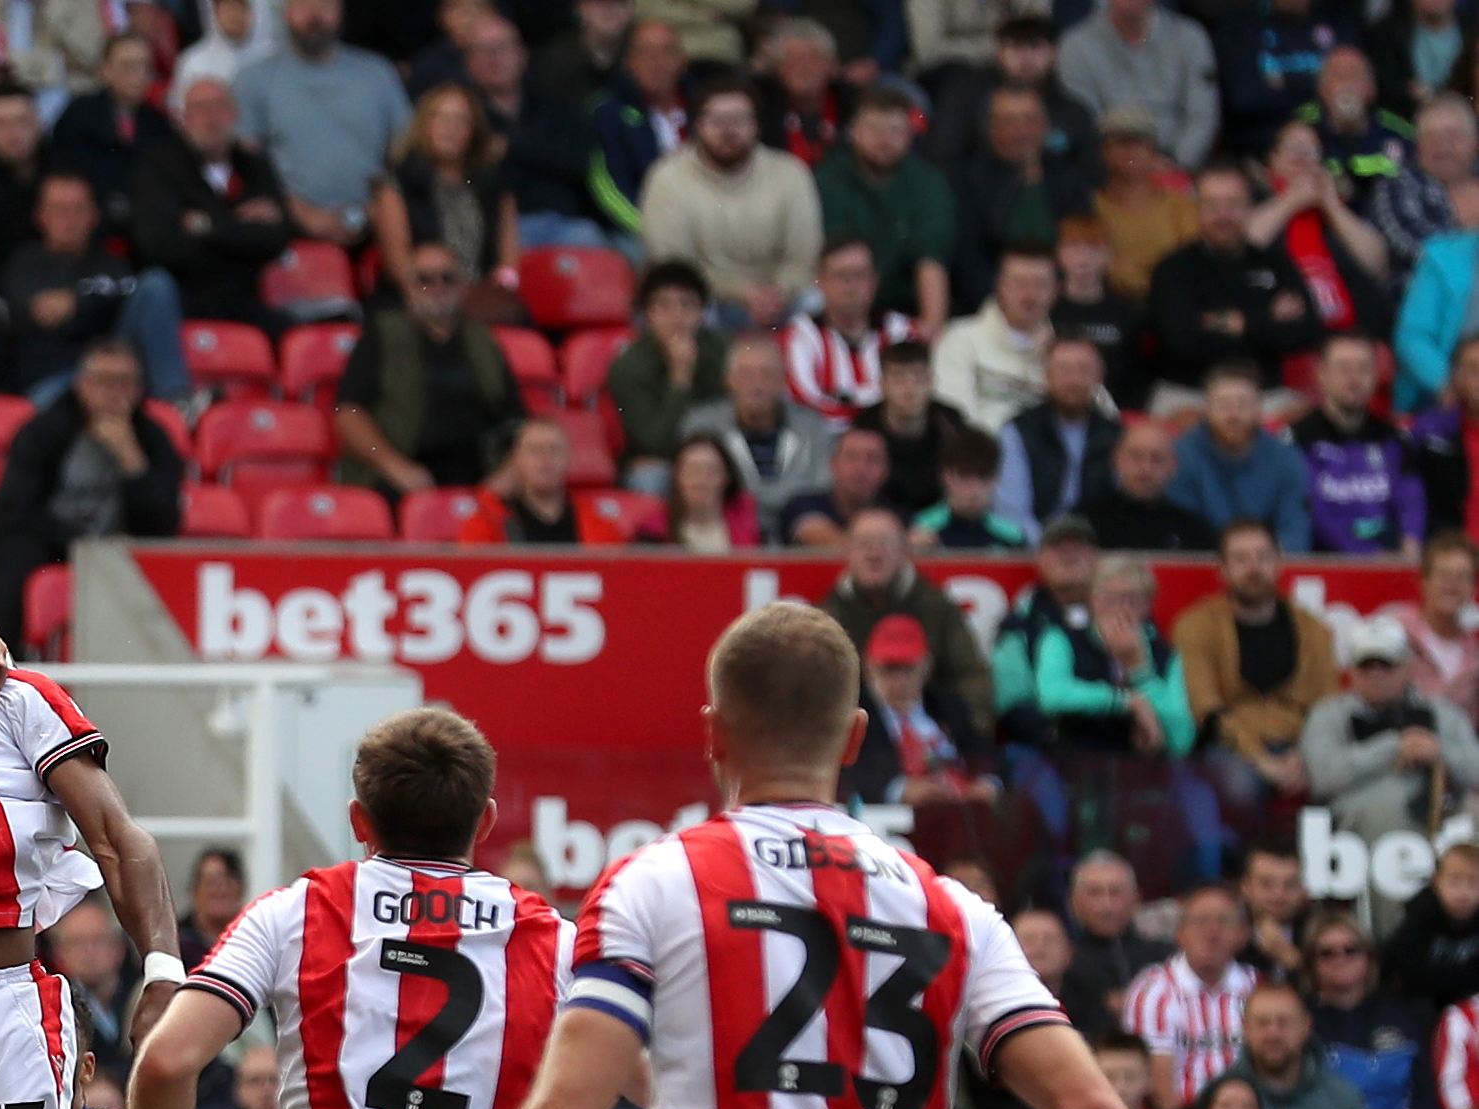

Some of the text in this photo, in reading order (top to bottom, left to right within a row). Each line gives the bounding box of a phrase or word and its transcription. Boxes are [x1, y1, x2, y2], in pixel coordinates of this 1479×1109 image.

[197, 561, 605, 666] bet365
[754, 837, 910, 885] GIBSON
[373, 889, 500, 930] GOOCH
